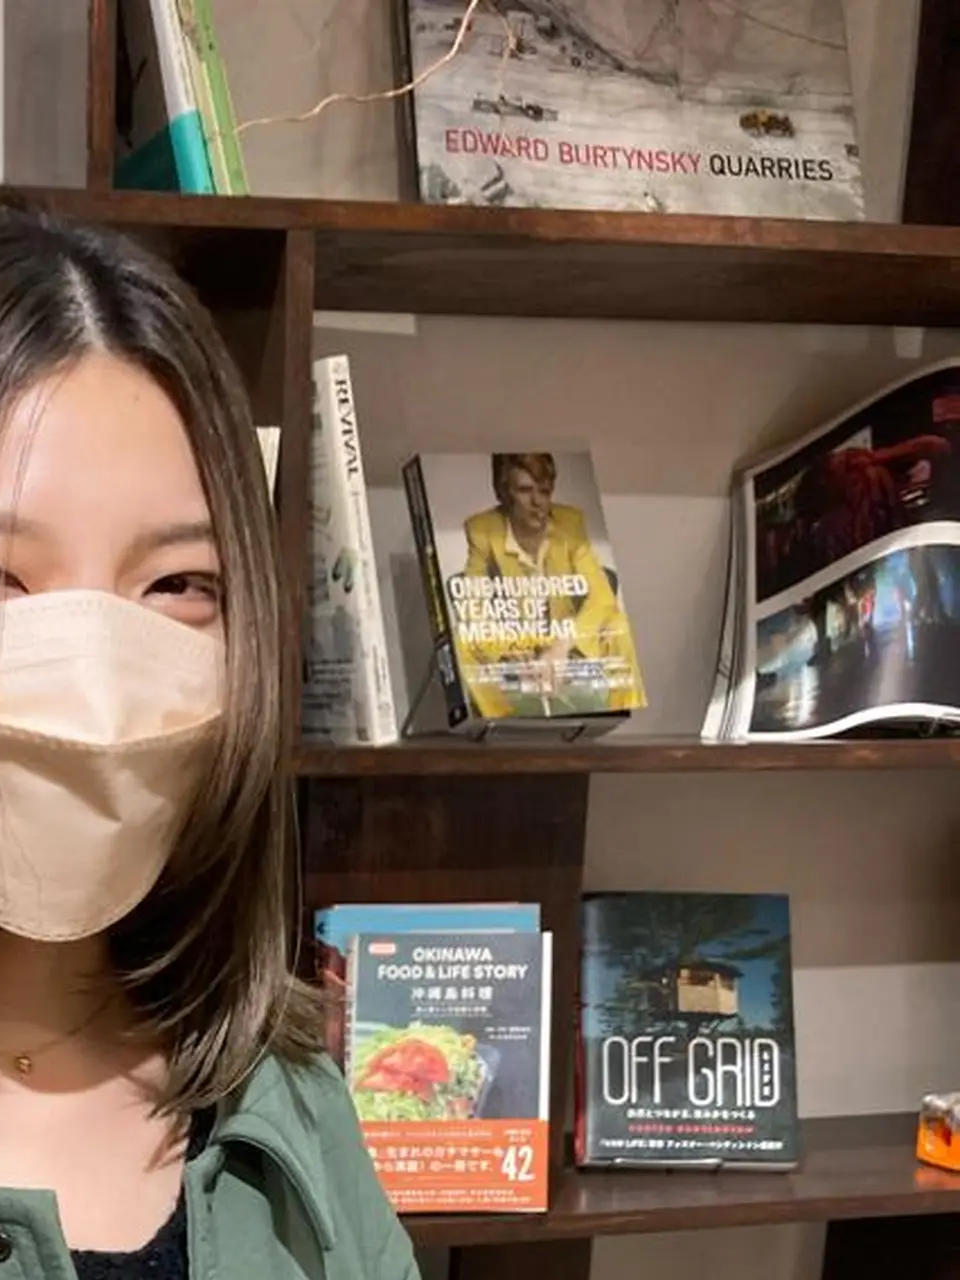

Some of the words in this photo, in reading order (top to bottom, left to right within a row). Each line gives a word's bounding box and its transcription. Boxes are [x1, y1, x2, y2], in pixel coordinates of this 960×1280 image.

[445, 129, 548, 163] EDWARD
[559, 142, 700, 173] BURTYNSKY
[709, 154, 833, 181] QUARRIES
[450, 576, 494, 598] ONE
[496, 574, 588, 598] HUNDRED
[454, 599, 520, 621] YEARS
[524, 599, 548, 619] OF
[458, 618, 578, 641] MENSWEAR
[412, 947, 493, 962] OKINAWA
[377, 964, 423, 980] FOOD
[425, 965, 435, 979] &
[438, 965, 471, 979] LIFE
[473, 964, 528, 979] STORY
[603, 1035, 677, 1105] OFF
[689, 1037, 781, 1107] GRID
[501, 1145, 536, 1182] 42
